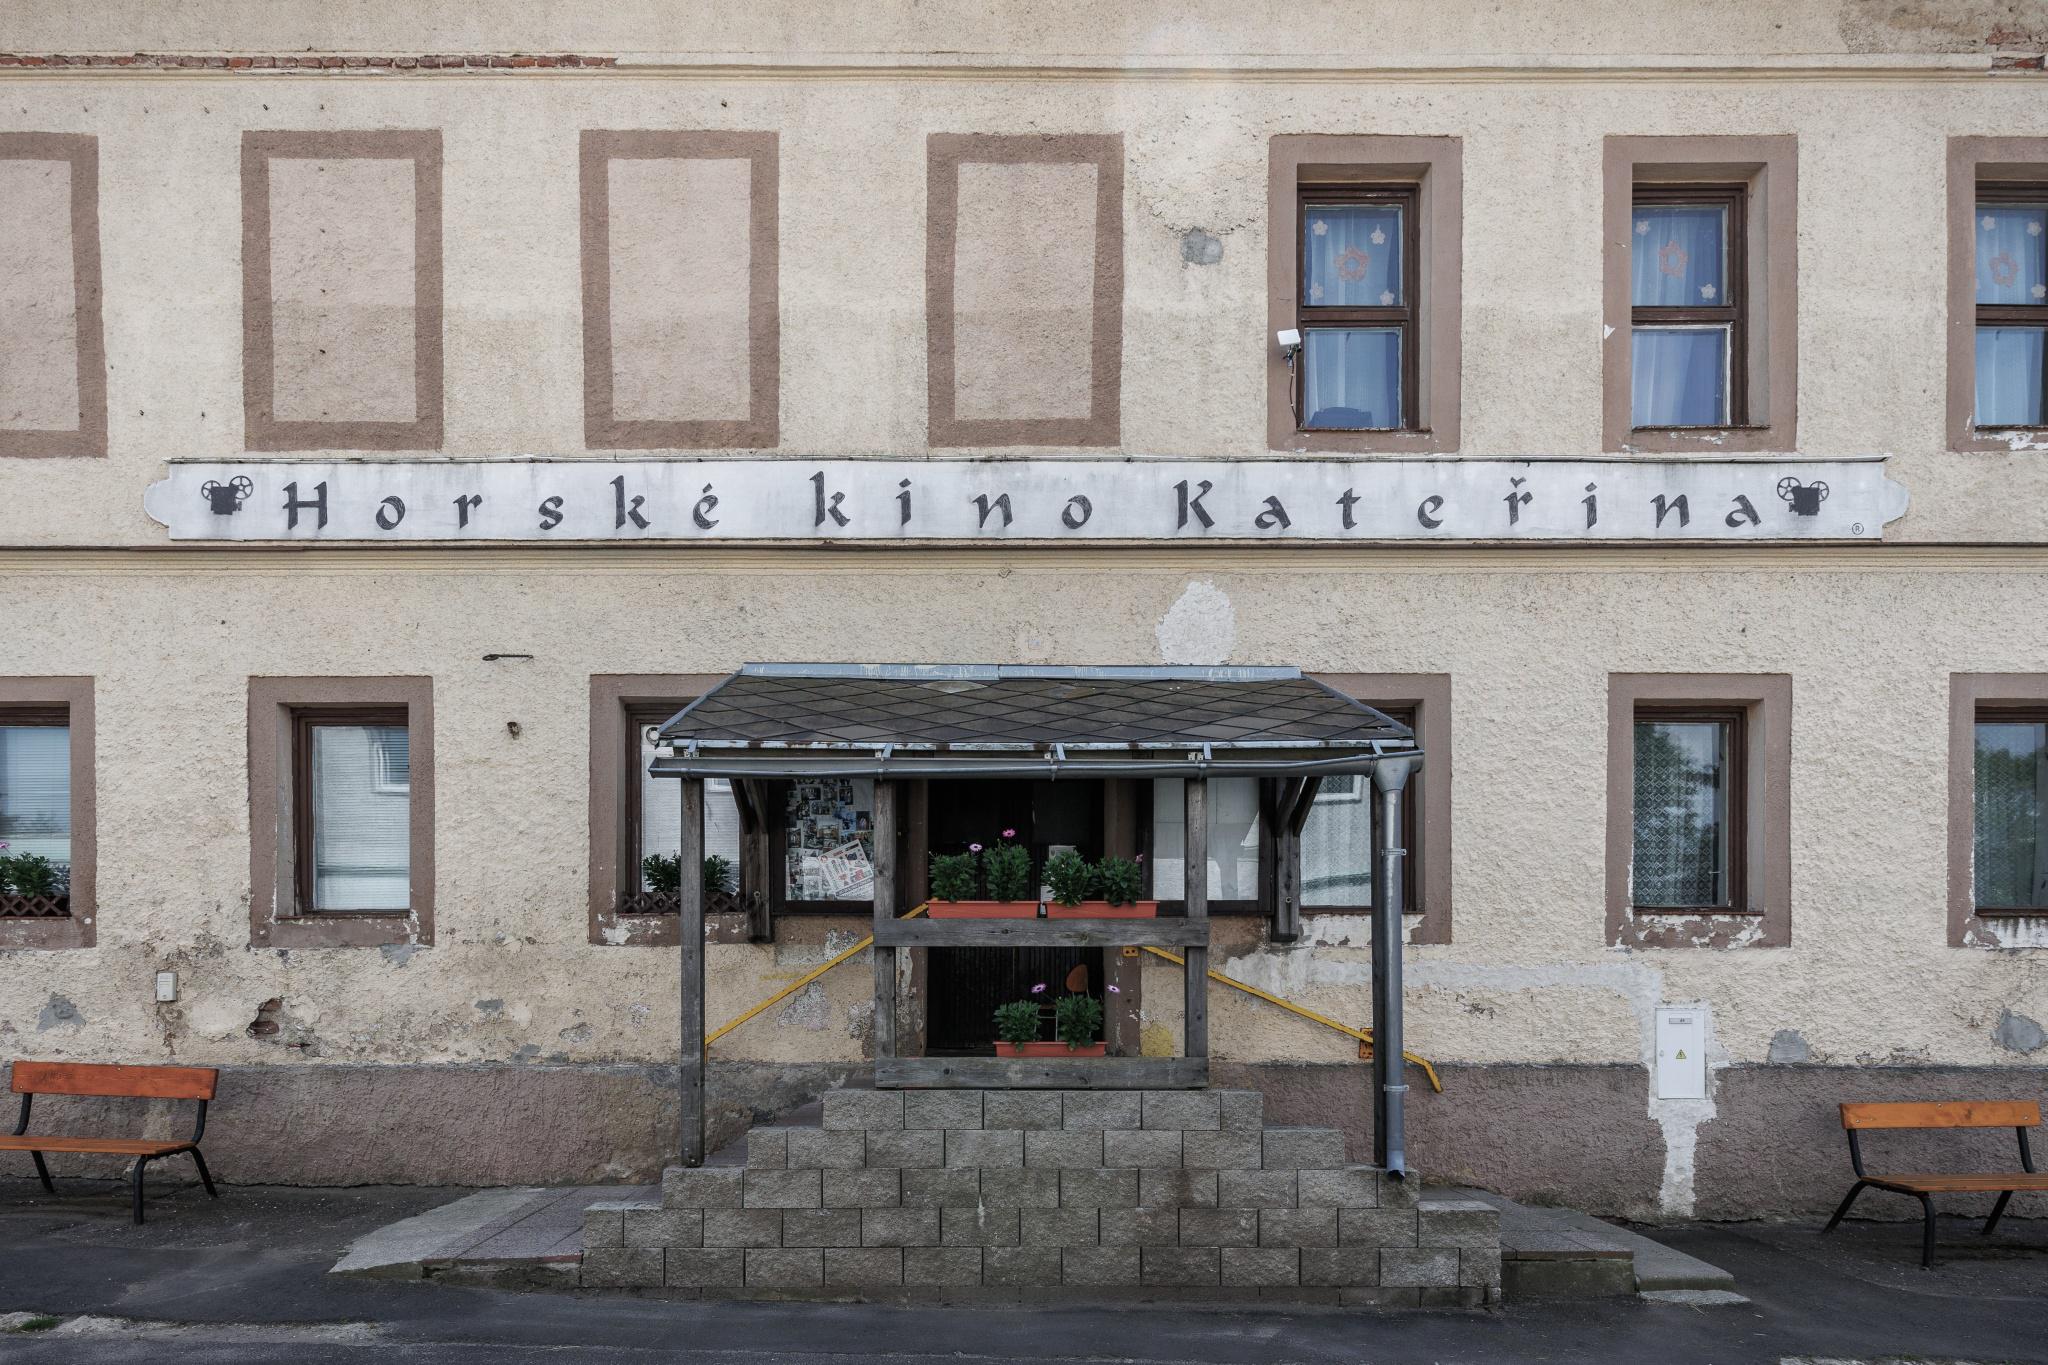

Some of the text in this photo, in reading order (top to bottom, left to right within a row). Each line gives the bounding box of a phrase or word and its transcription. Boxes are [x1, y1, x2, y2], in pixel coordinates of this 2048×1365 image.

[281, 470, 1762, 531] Horské kino Kateřina
